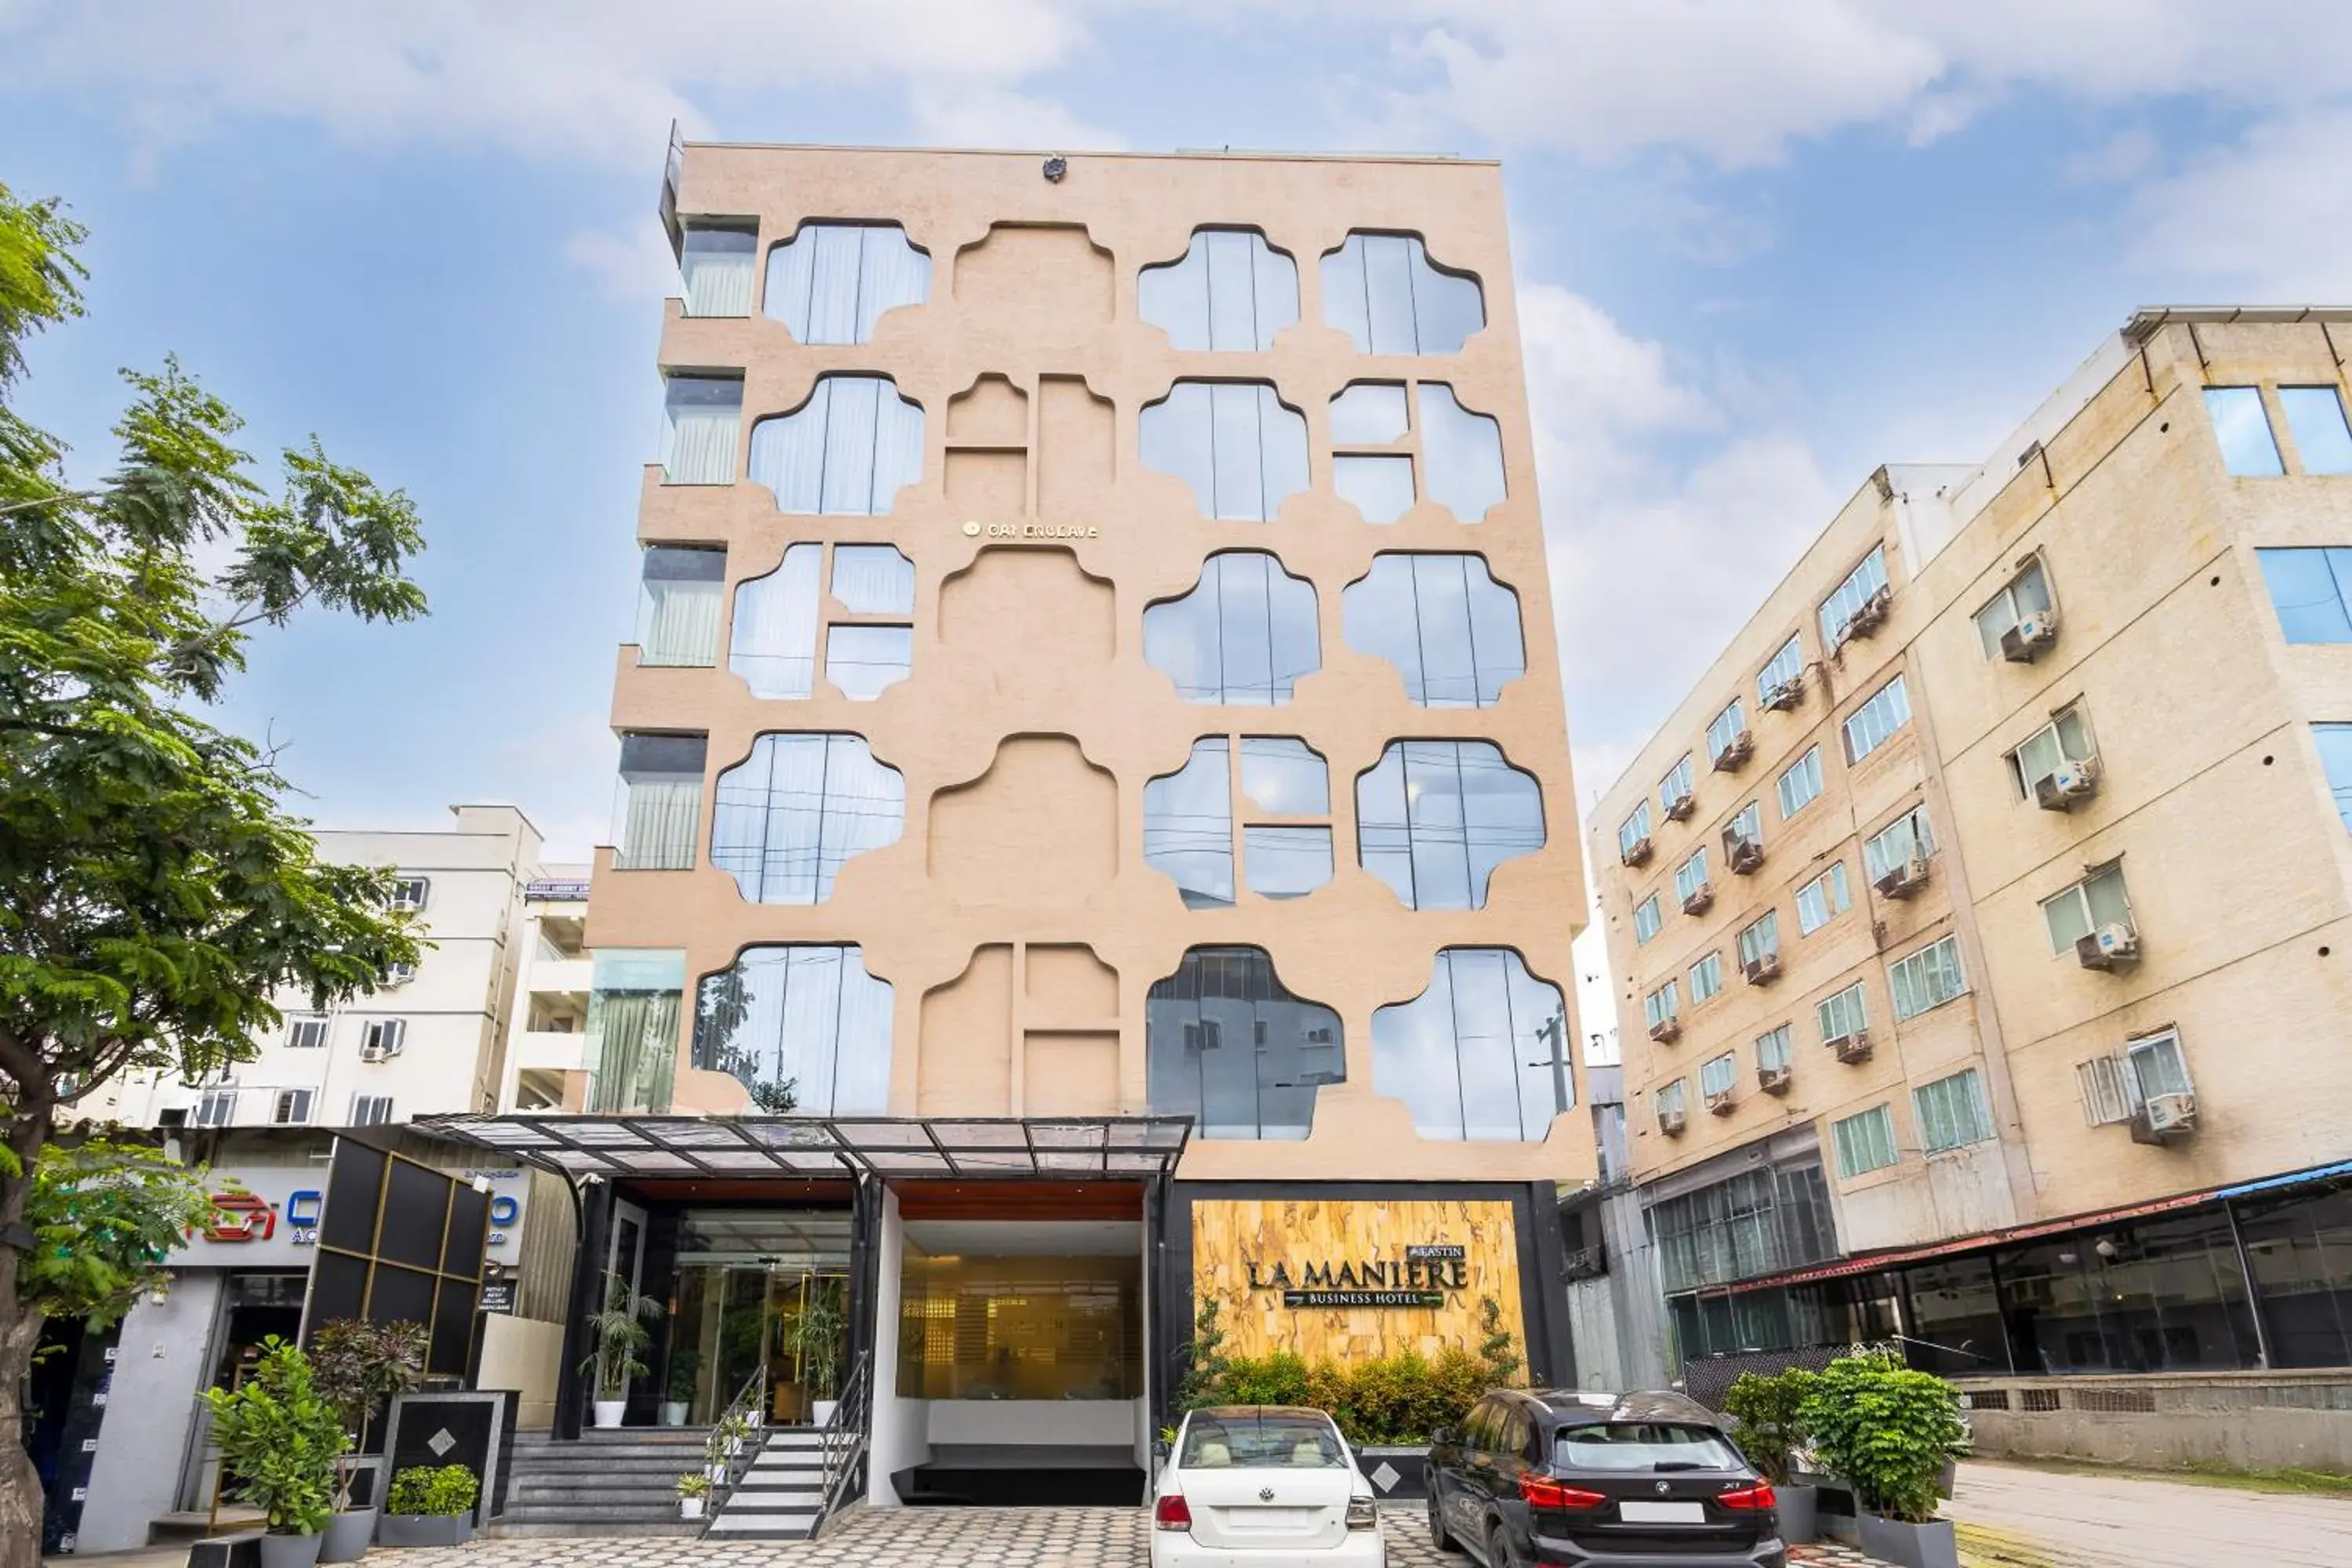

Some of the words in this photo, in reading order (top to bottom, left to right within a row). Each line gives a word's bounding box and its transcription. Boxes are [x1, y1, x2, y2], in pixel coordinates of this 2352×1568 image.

[1417, 1247, 1462, 1257] EASTIN
[1247, 1260, 1294, 1290] LA
[1303, 1260, 1469, 1290] MANIERE
[1309, 1294, 1371, 1305] BUSINESS
[1376, 1294, 1420, 1305] HOTEL
